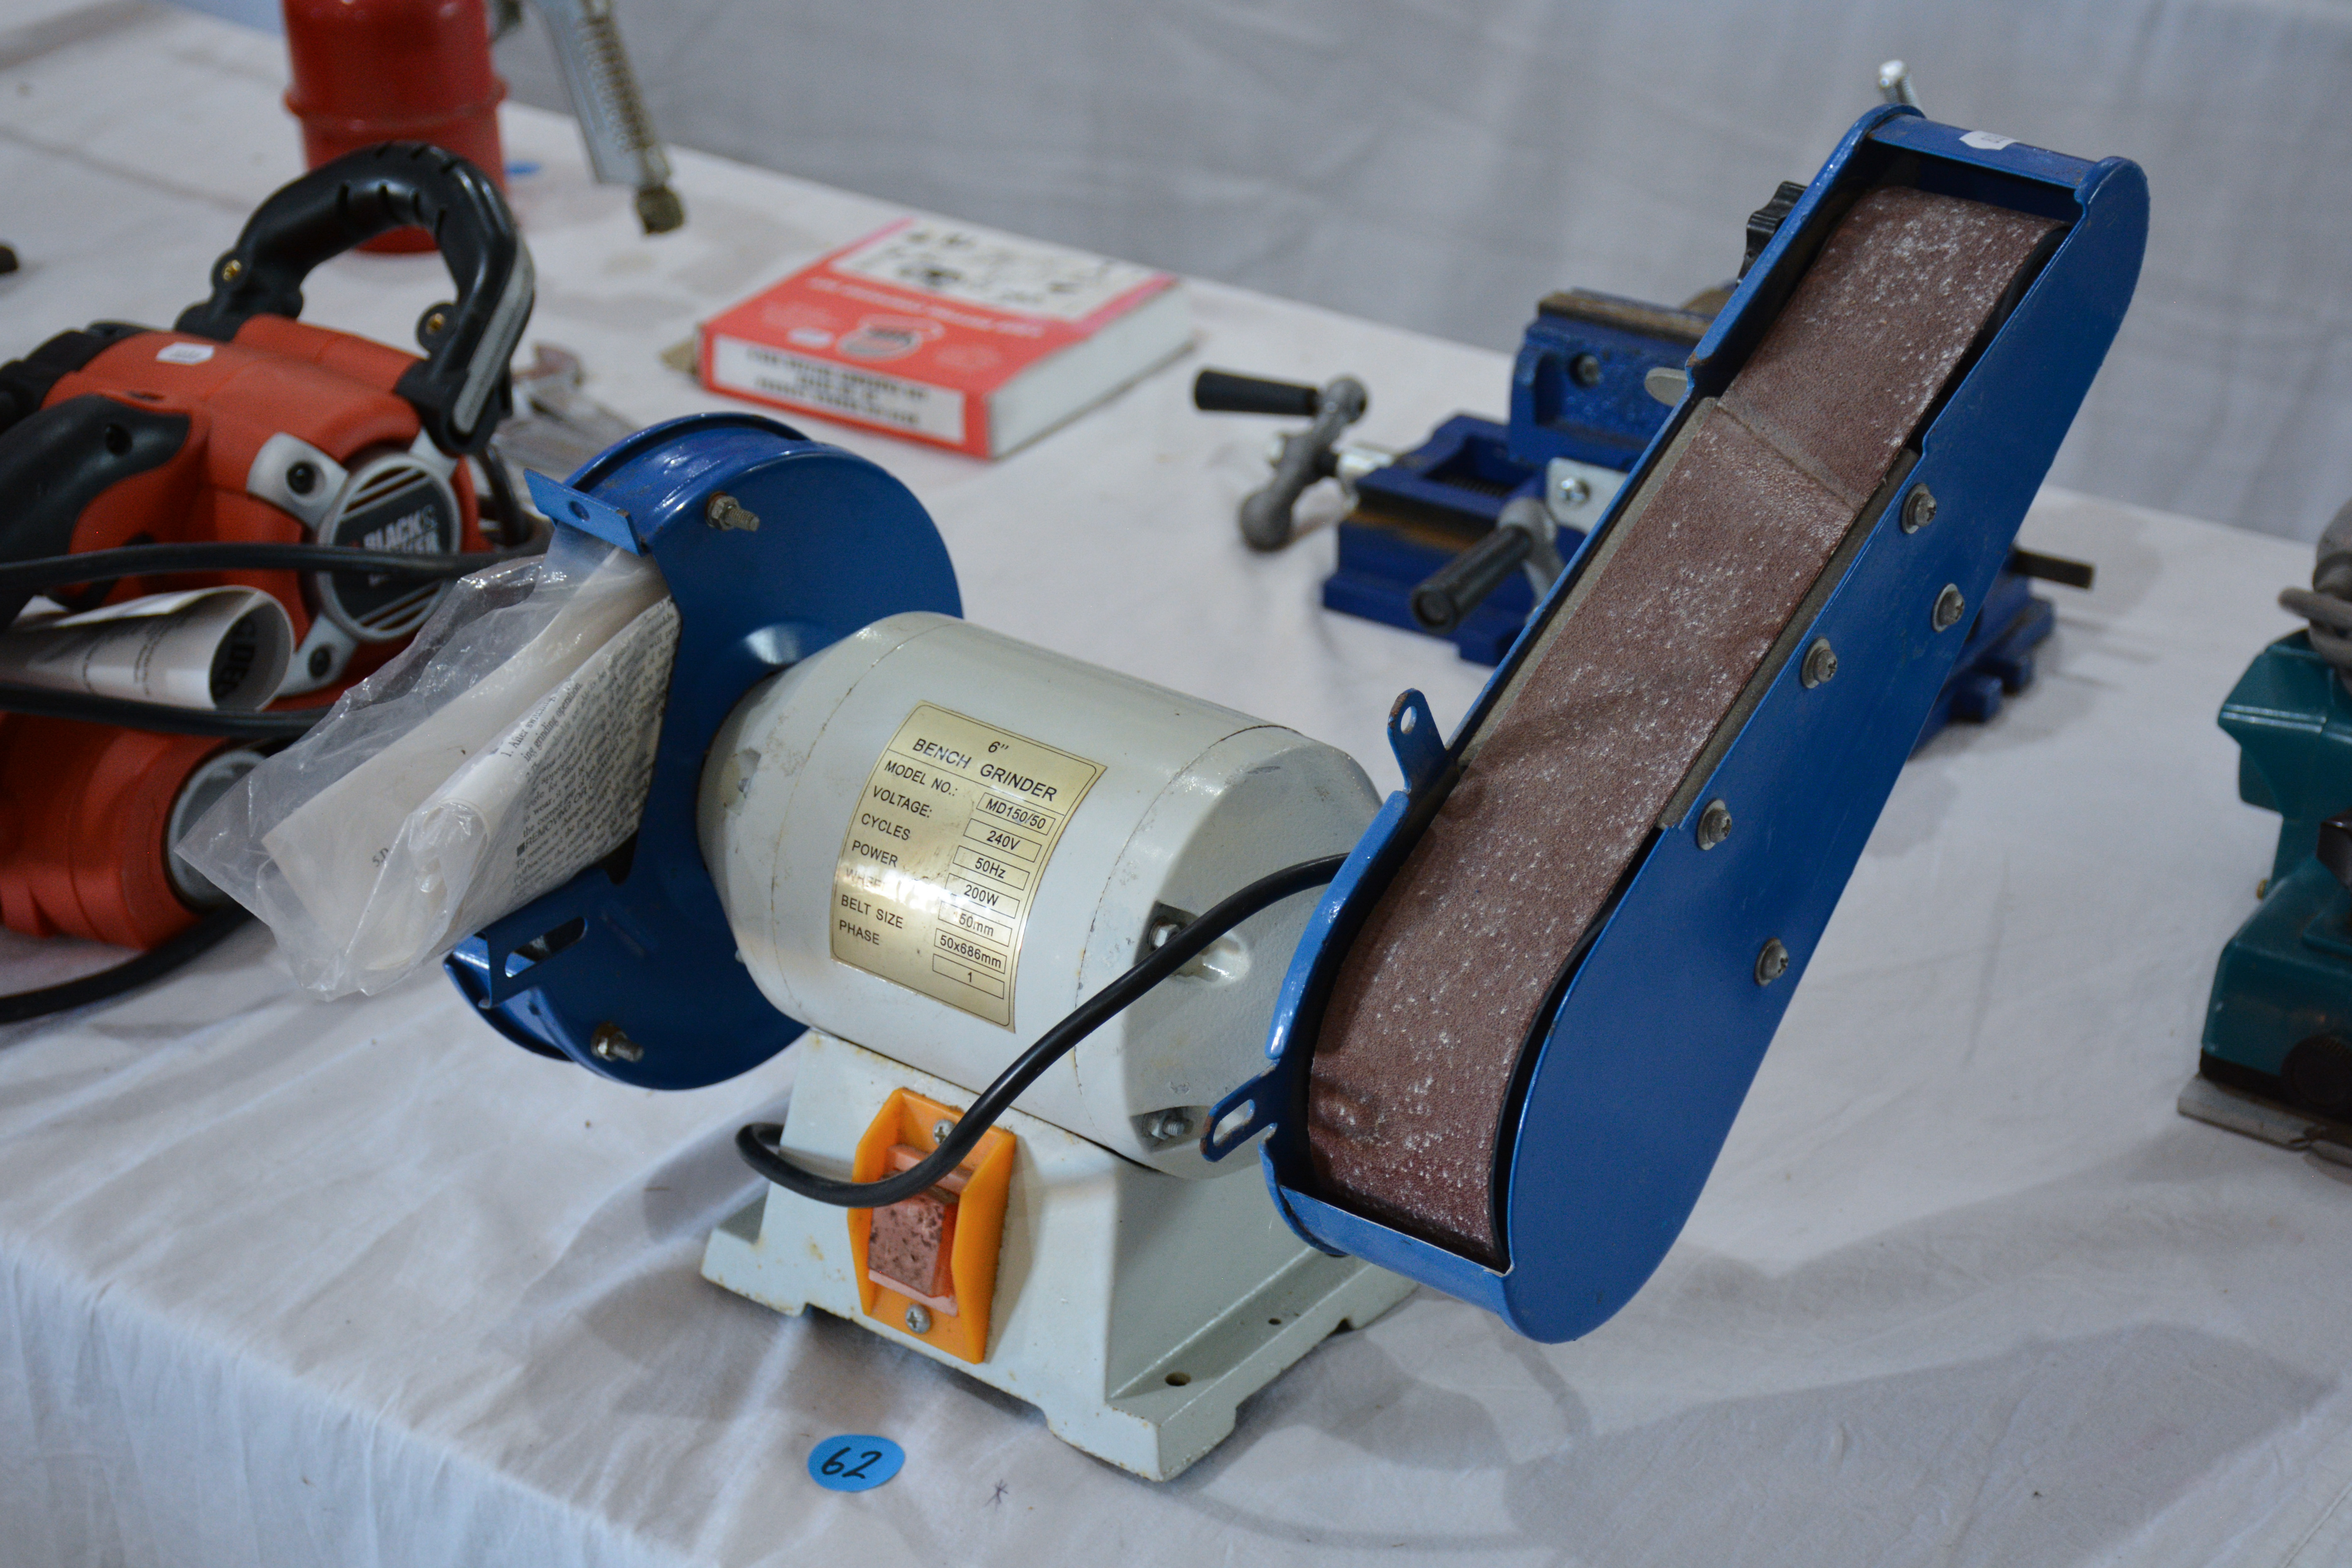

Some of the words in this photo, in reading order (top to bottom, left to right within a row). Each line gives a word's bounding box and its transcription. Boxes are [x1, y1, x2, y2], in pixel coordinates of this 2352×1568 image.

[521, 747, 537, 762] ing
[534, 715, 558, 751] grinding
[912, 738, 972, 769] BENCH
[980, 764, 1057, 802] GRINDER
[874, 785, 932, 818] VOLTAGE:
[986, 831, 1021, 850] 240V
[884, 760, 926, 785] MODEL
[931, 778, 958, 796] NO.:
[986, 798, 1046, 829] MD150/50
[852, 840, 898, 868] POWER
[964, 884, 999, 906] 200W
[862, 813, 910, 841] CYCLES
[975, 858, 1006, 879] 50Hz
[846, 868, 885, 891] WHEE
[839, 920, 880, 945] PHASE
[968, 971, 972, 983] 1
[841, 894, 871, 915] BELT
[876, 909, 903, 929] SIZE
[940, 935, 1001, 969] 50x686mm
[822, 1447, 882, 1479] 62
